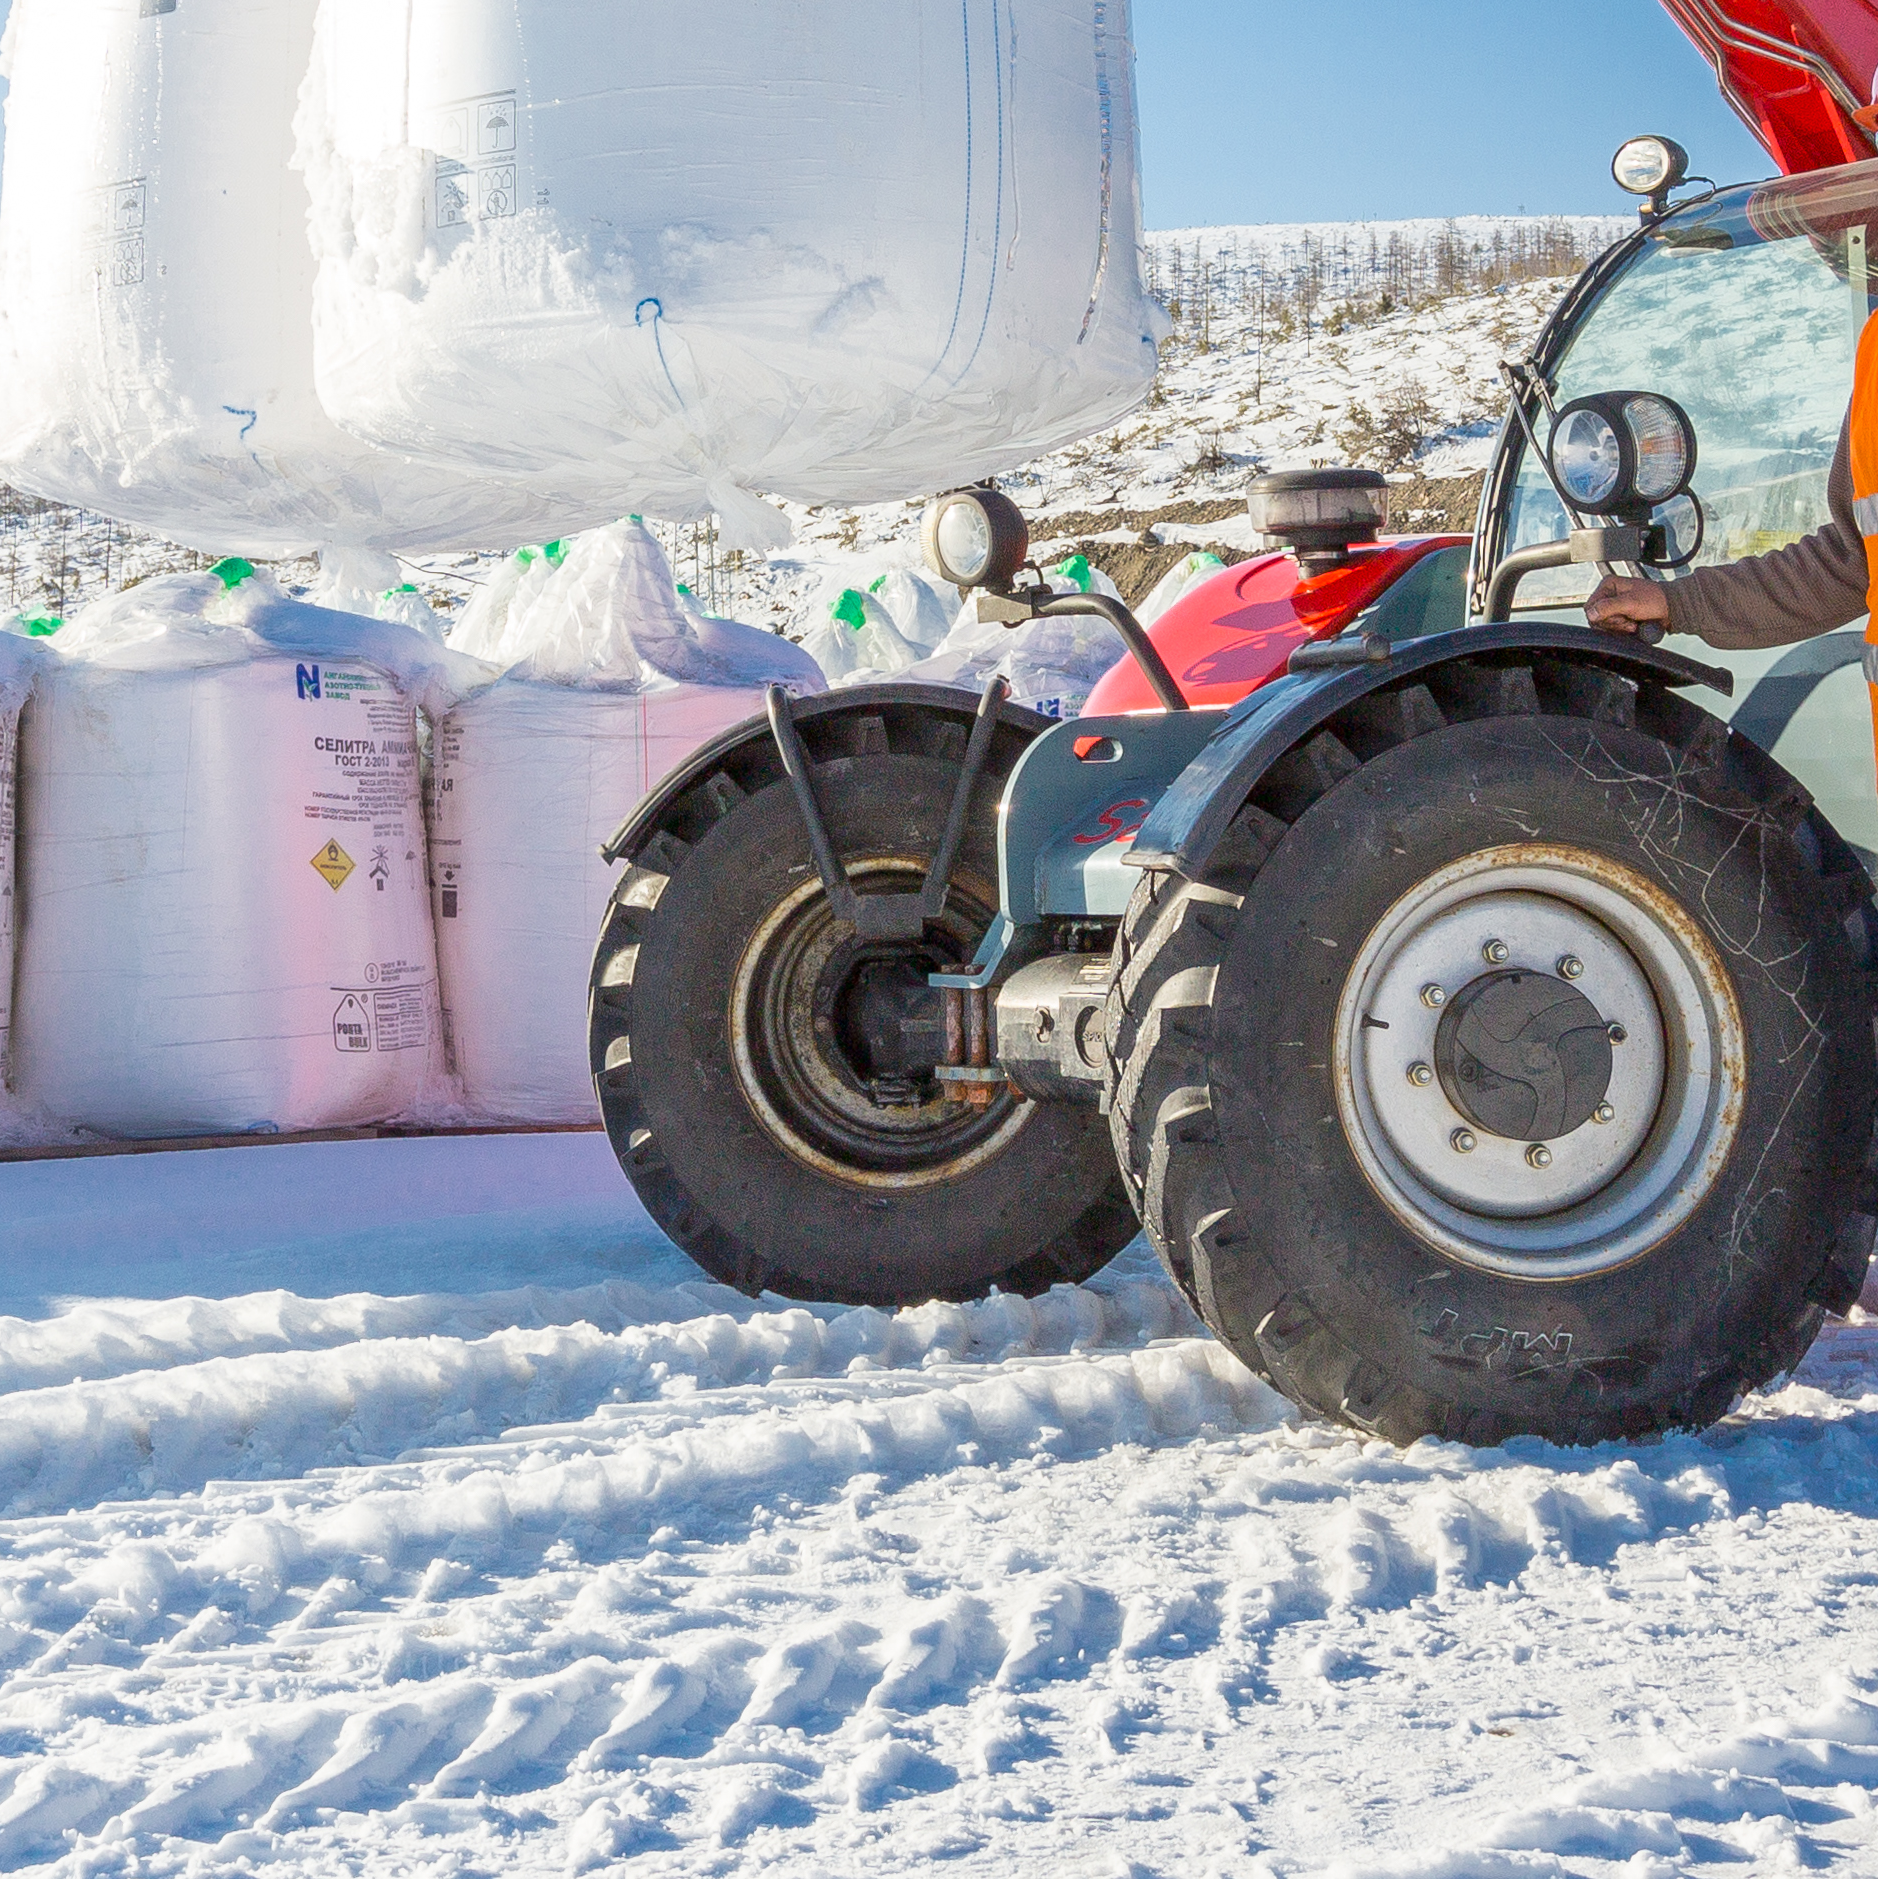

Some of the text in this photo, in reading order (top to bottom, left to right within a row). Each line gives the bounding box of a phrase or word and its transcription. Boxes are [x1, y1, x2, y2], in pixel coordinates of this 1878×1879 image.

[314, 736, 376, 754] СЕЛИТРА
[335, 754, 362, 766] ГОСТ
[364, 756, 390, 768] 2-2013
